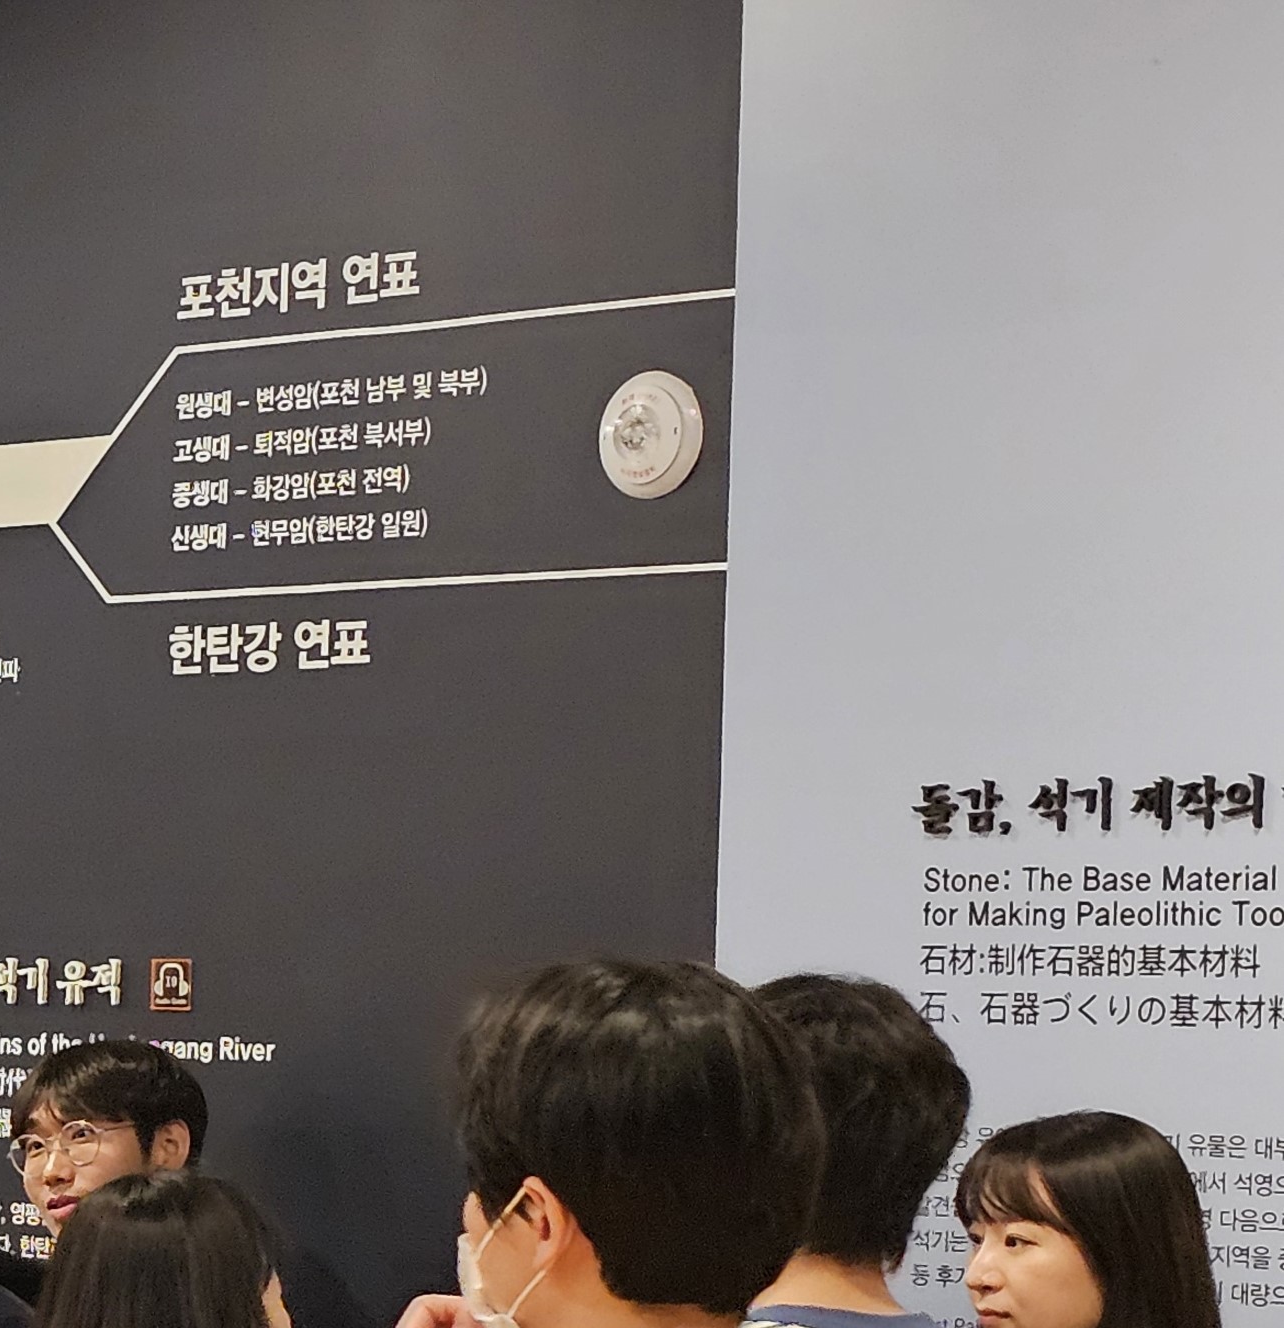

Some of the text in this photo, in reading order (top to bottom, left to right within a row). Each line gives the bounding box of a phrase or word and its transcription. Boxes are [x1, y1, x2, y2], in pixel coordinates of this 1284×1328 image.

[177, 251, 419, 320] 포천지역 연표
[176, 365, 487, 420] 원생대 변성암(포천 남부 및 북부)
[173, 417, 430, 462] 고생대 퇴적암(포천 북서부)
[172, 464, 410, 508] 중생대 화강암(포천 전역)
[171, 508, 427, 551] 신생대 현무암(한탄강 일원)
[169, 619, 370, 675] 한탄강 연표
[1029, 777, 1113, 831] 석기
[1131, 774, 1265, 830] 제작의
[924, 865, 1276, 892] Stone: The Base Material
[923, 902, 958, 926] for
[969, 901, 1065, 929] Making
[1078, 901, 1221, 926] Paleolithic
[56, 958, 121, 1006] 유적
[920, 944, 1260, 978] 石材:制作石器的基本材料
[27, 1032, 47, 1056] of
[219, 1036, 275, 1062] River
[1188, 1134, 1247, 1159] 유물은
[1220, 1209, 1284, 1232] 다음으
